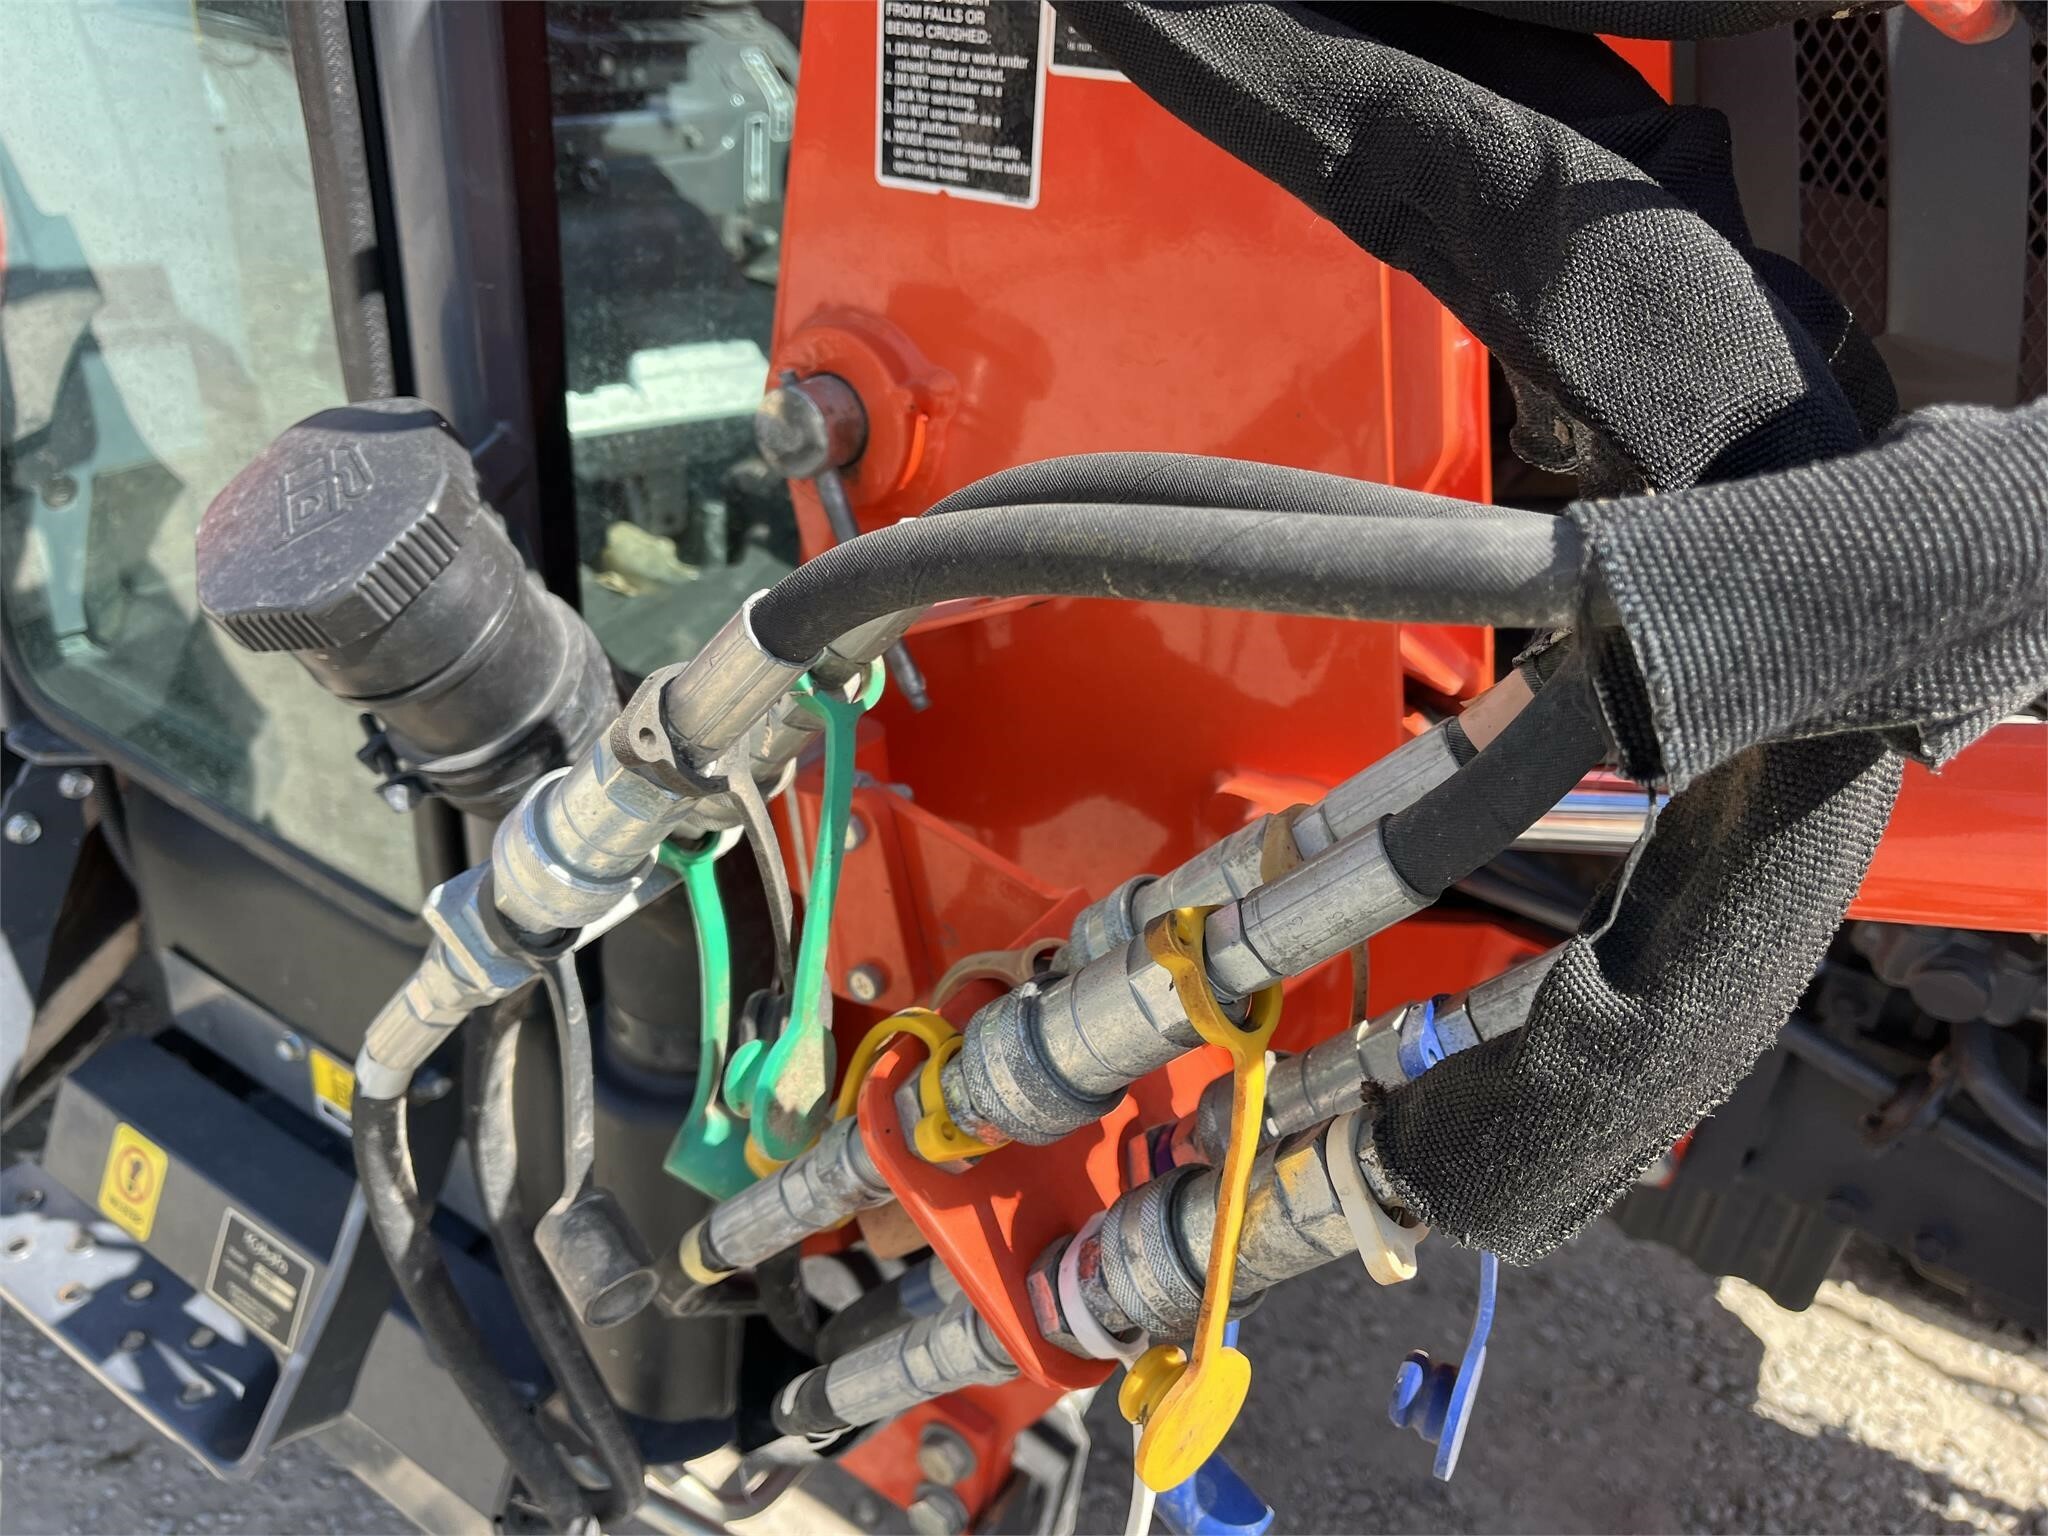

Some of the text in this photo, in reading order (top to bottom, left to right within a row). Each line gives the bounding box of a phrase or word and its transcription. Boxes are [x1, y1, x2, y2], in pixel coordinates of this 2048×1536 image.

[885, 2, 922, 19] FROM
[923, 6, 963, 23] FALLS
[965, 10, 986, 25] OR
[885, 20, 992, 45] BEING CRUSHED:
[894, 42, 910, 57] DO
[910, 44, 930, 59] NOT
[931, 48, 959, 61] stand
[971, 53, 998, 66] work
[998, 55, 1029, 69] under
[895, 59, 925, 73] raised
[926, 61, 956, 77] loader
[894, 72, 909, 86] DO
[910, 73, 930, 89] NOT
[930, 78, 948, 91] use
[949, 78, 980, 95] loader
[894, 87, 916, 103] jack
[893, 101, 909, 115] DO
[909, 102, 929, 118] NOT
[929, 107, 947, 121] use
[948, 108, 979, 124] loader
[894, 118, 918, 131] work
[893, 131, 924, 147] NEVER
[925, 136, 962, 151] connect
[993, 144, 1022, 160] cable
[893, 160, 937, 180] operating
[938, 152, 969, 168] loader
[969, 156, 1003, 173] bucket
[1003, 161, 1031, 176] while
